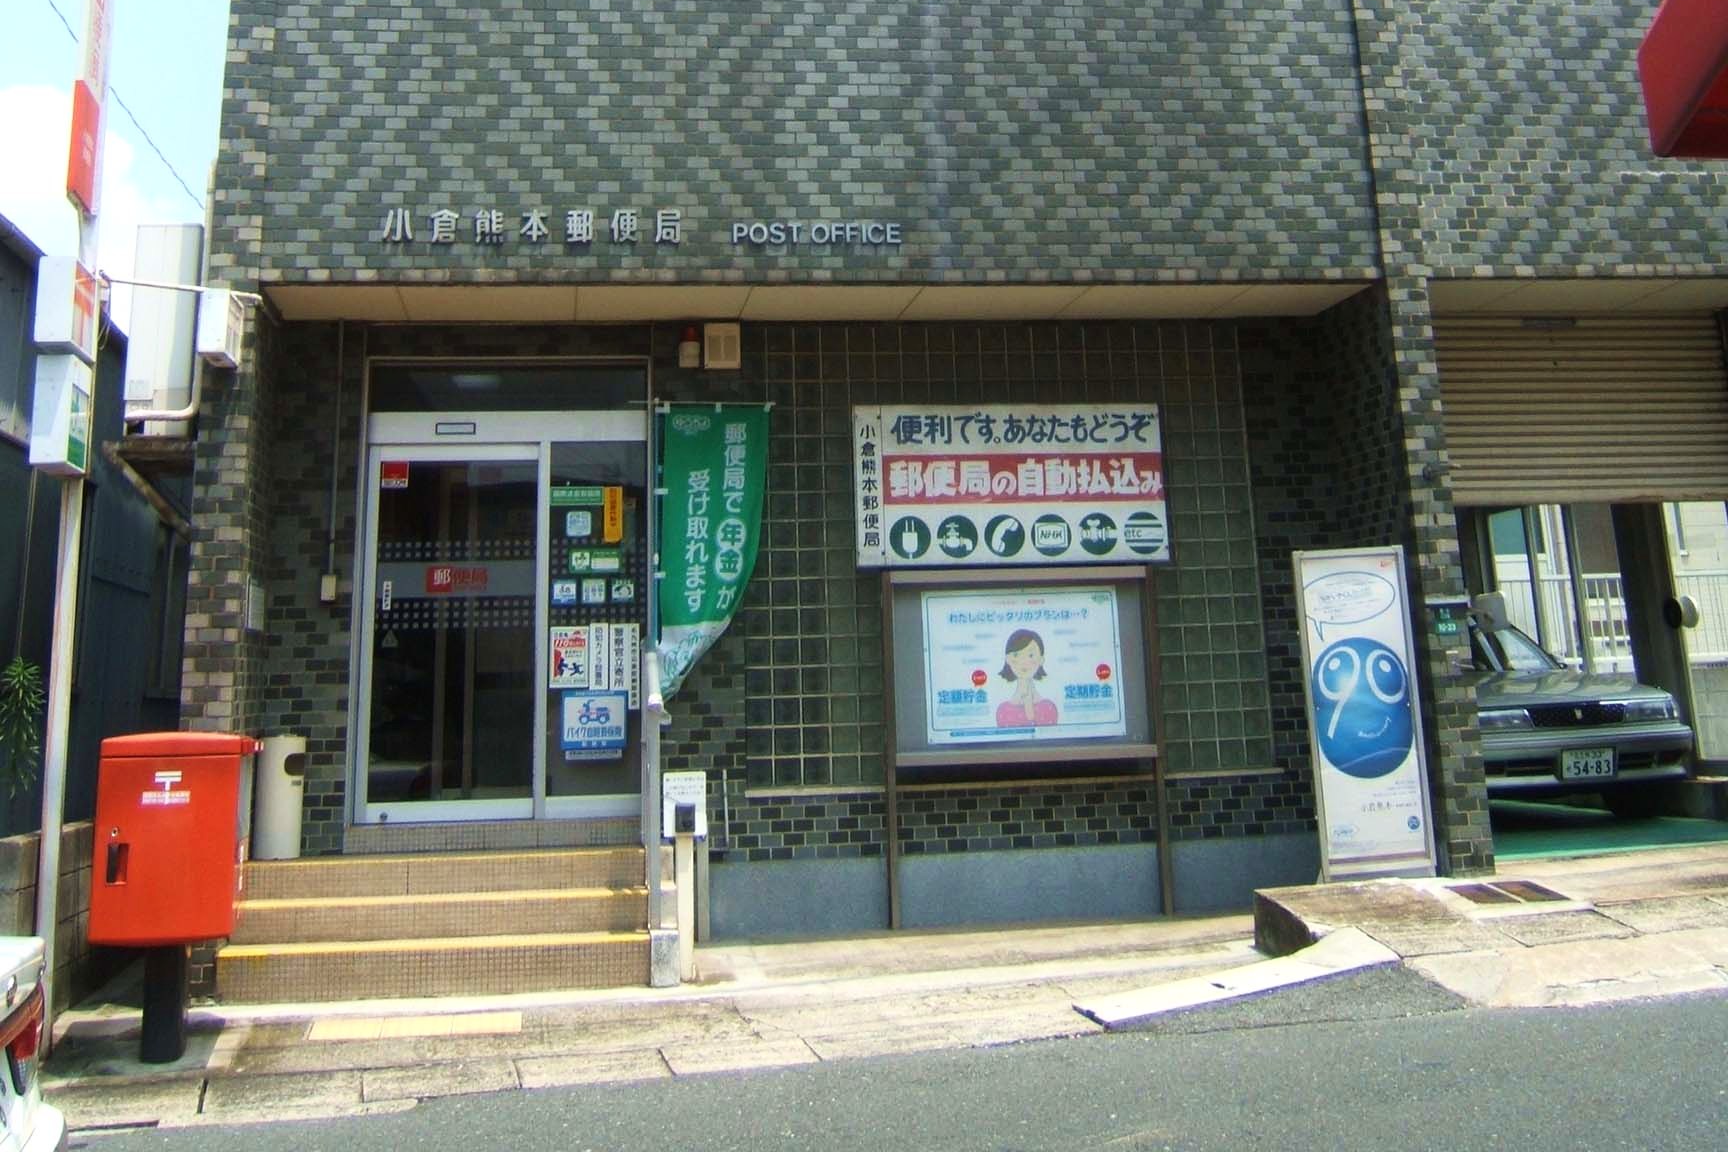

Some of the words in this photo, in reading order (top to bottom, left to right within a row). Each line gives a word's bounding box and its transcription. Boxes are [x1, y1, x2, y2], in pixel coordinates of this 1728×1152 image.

[381, 207, 682, 244] 小倉熊本郵便局
[732, 222, 802, 244] POST
[811, 222, 902, 244] OFFICE
[890, 412, 1157, 446] 便利です。あなたもどうぞ
[859, 423, 881, 548] 小倉熊本郵便局
[889, 458, 1163, 498] 郵便局の自動払込み
[715, 422, 748, 610] 郵便局で年金が
[1124, 526, 1143, 539] etc
[684, 467, 711, 614] 受け取れます
[1039, 528, 1065, 541] NHK
[1573, 759, 1611, 776] 54-83
